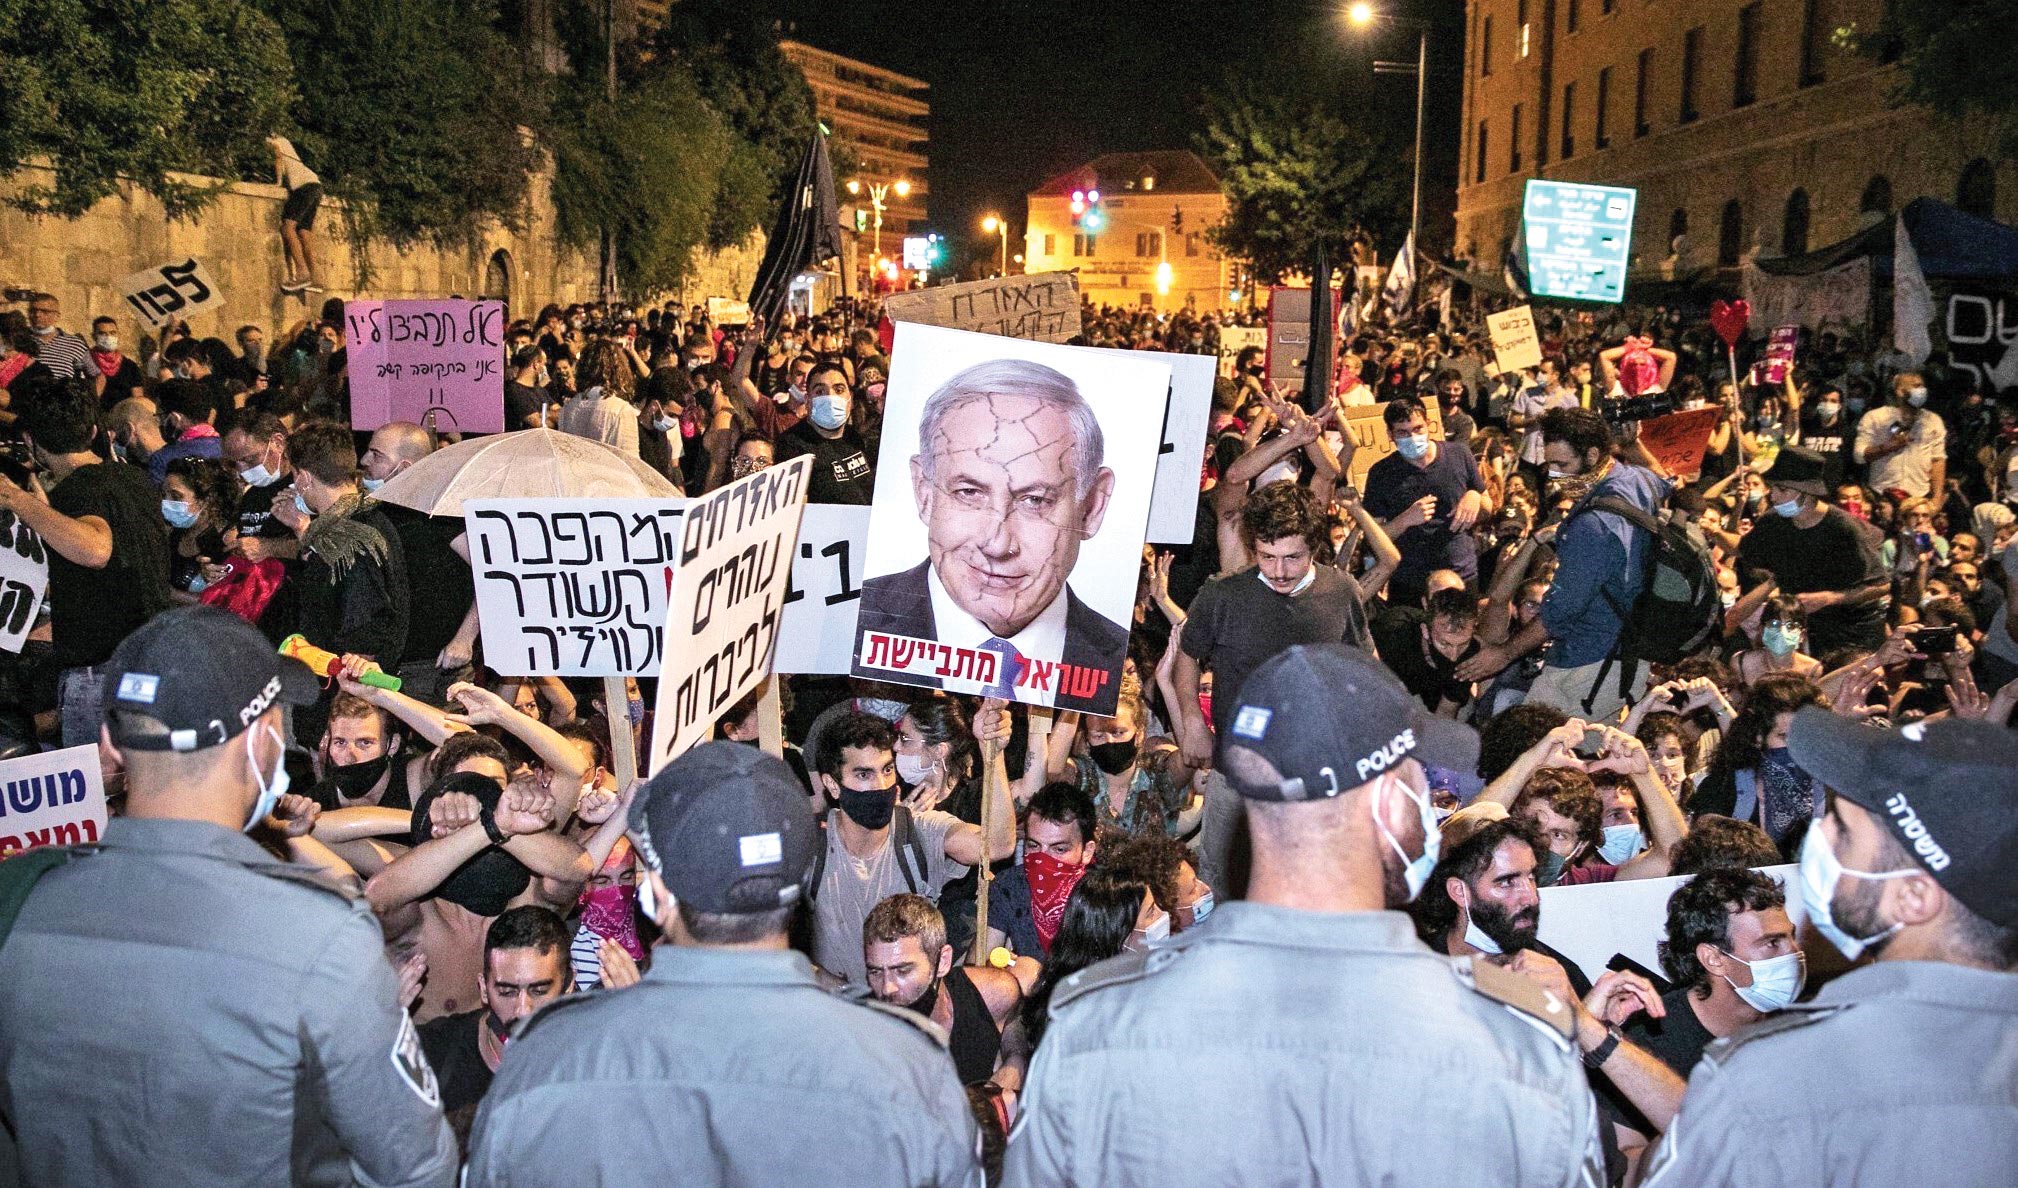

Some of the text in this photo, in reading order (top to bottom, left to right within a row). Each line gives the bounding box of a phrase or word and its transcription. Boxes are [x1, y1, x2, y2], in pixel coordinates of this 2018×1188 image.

[126, 257, 211, 325] לכו!
[463, 304, 500, 347] אל
[375, 360, 498, 381] אני בתקופה קשה
[681, 460, 805, 567] האזרחים
[484, 568, 650, 624] תשודר
[692, 532, 782, 636] נוהרים
[521, 605, 662, 673] לוויזיה
[866, 634, 1109, 698] ישראל מתביישת
[240, 675, 283, 727] POLICE
[667, 592, 777, 756] לכיכרות
[1355, 728, 1417, 781] POLICE
[0, 768, 87, 818] מוש
[1885, 792, 1951, 872] משטרה
